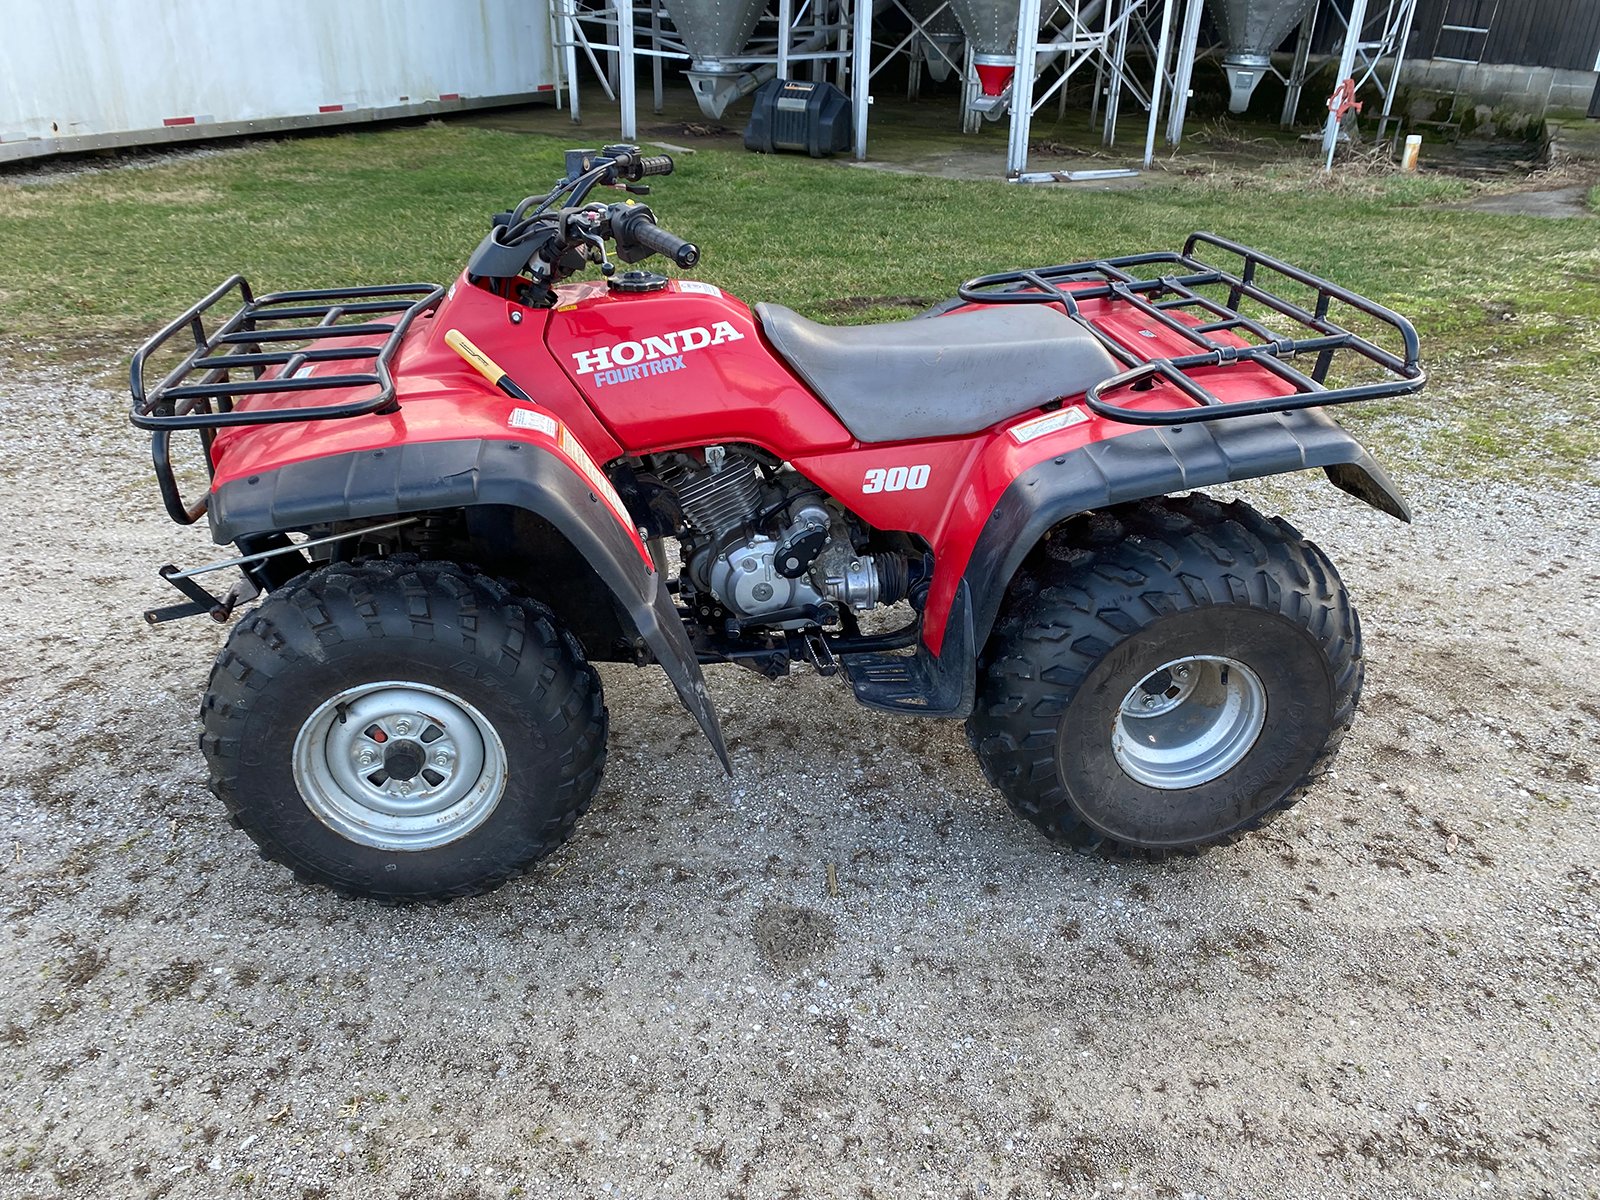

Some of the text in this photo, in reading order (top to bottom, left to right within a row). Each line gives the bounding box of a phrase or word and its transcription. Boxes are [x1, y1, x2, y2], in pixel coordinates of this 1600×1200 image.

[571, 320, 745, 375] HONDA
[594, 354, 687, 388] FOURTRAX
[862, 464, 931, 494] 300
